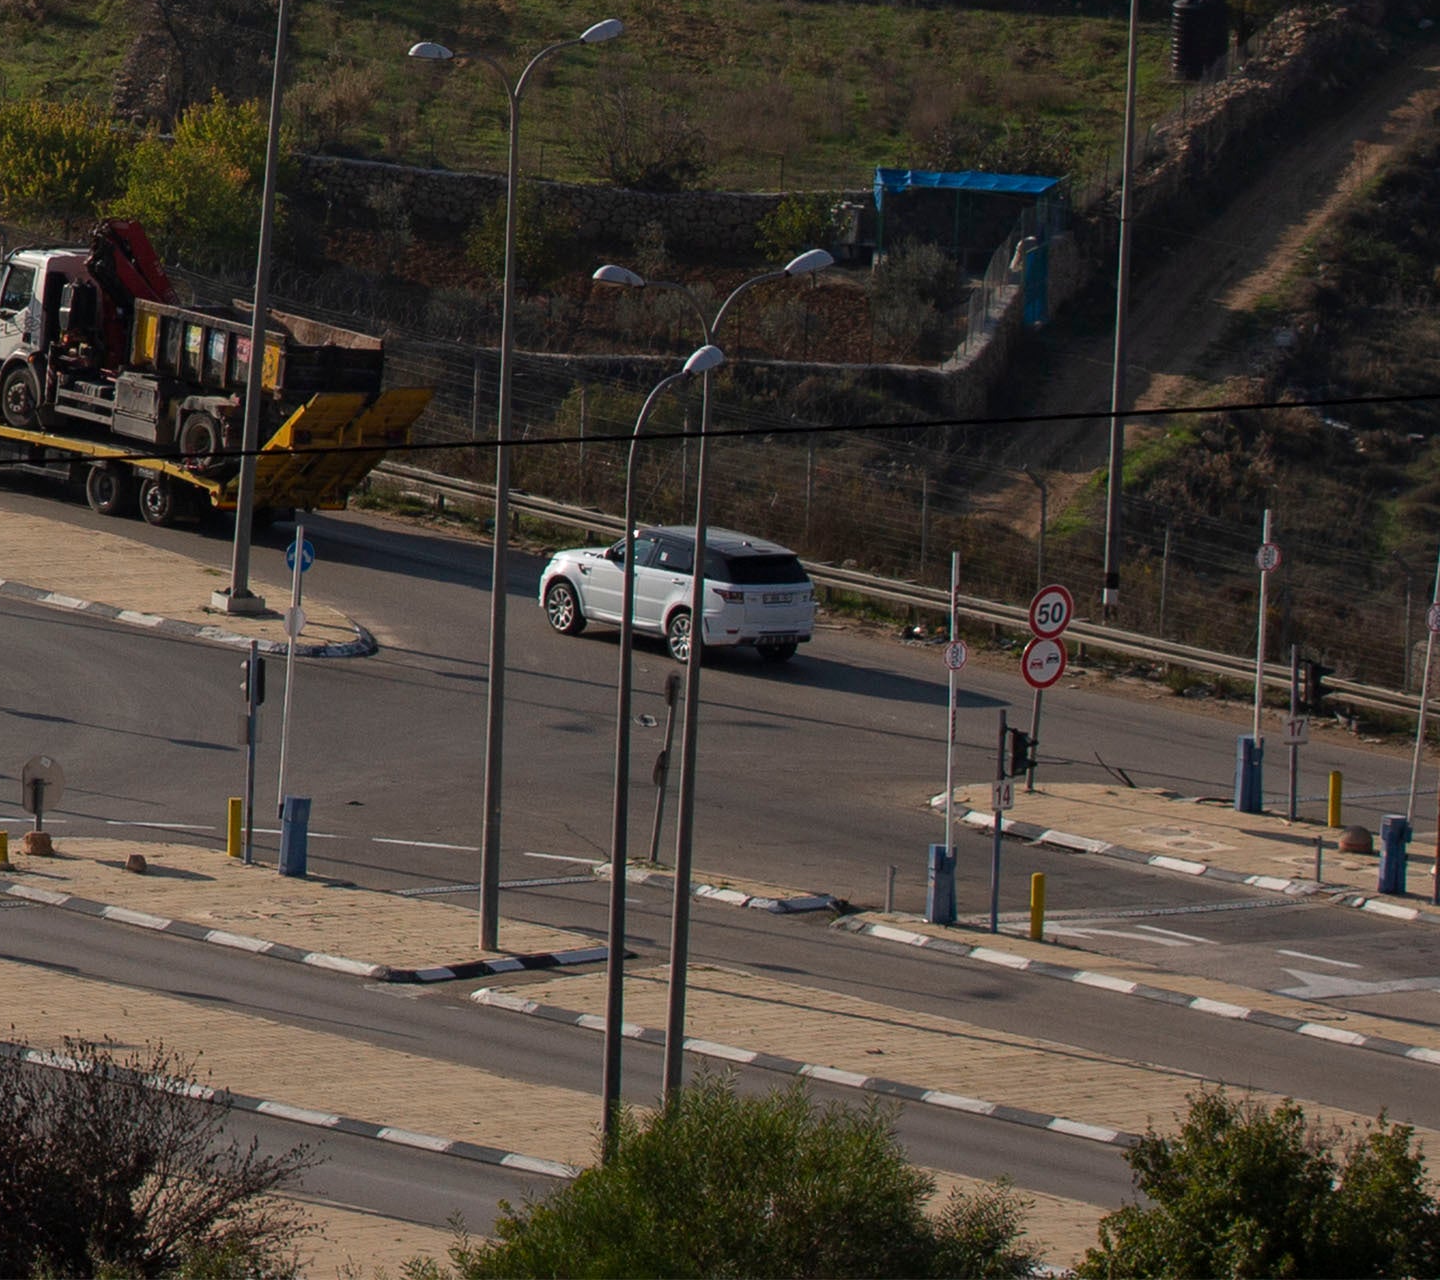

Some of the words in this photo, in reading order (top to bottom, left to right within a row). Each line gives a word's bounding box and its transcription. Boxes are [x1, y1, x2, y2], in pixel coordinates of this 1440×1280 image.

[1037, 601, 1064, 625] 50
[1288, 719, 1305, 737] 17
[995, 784, 1011, 806] 14
